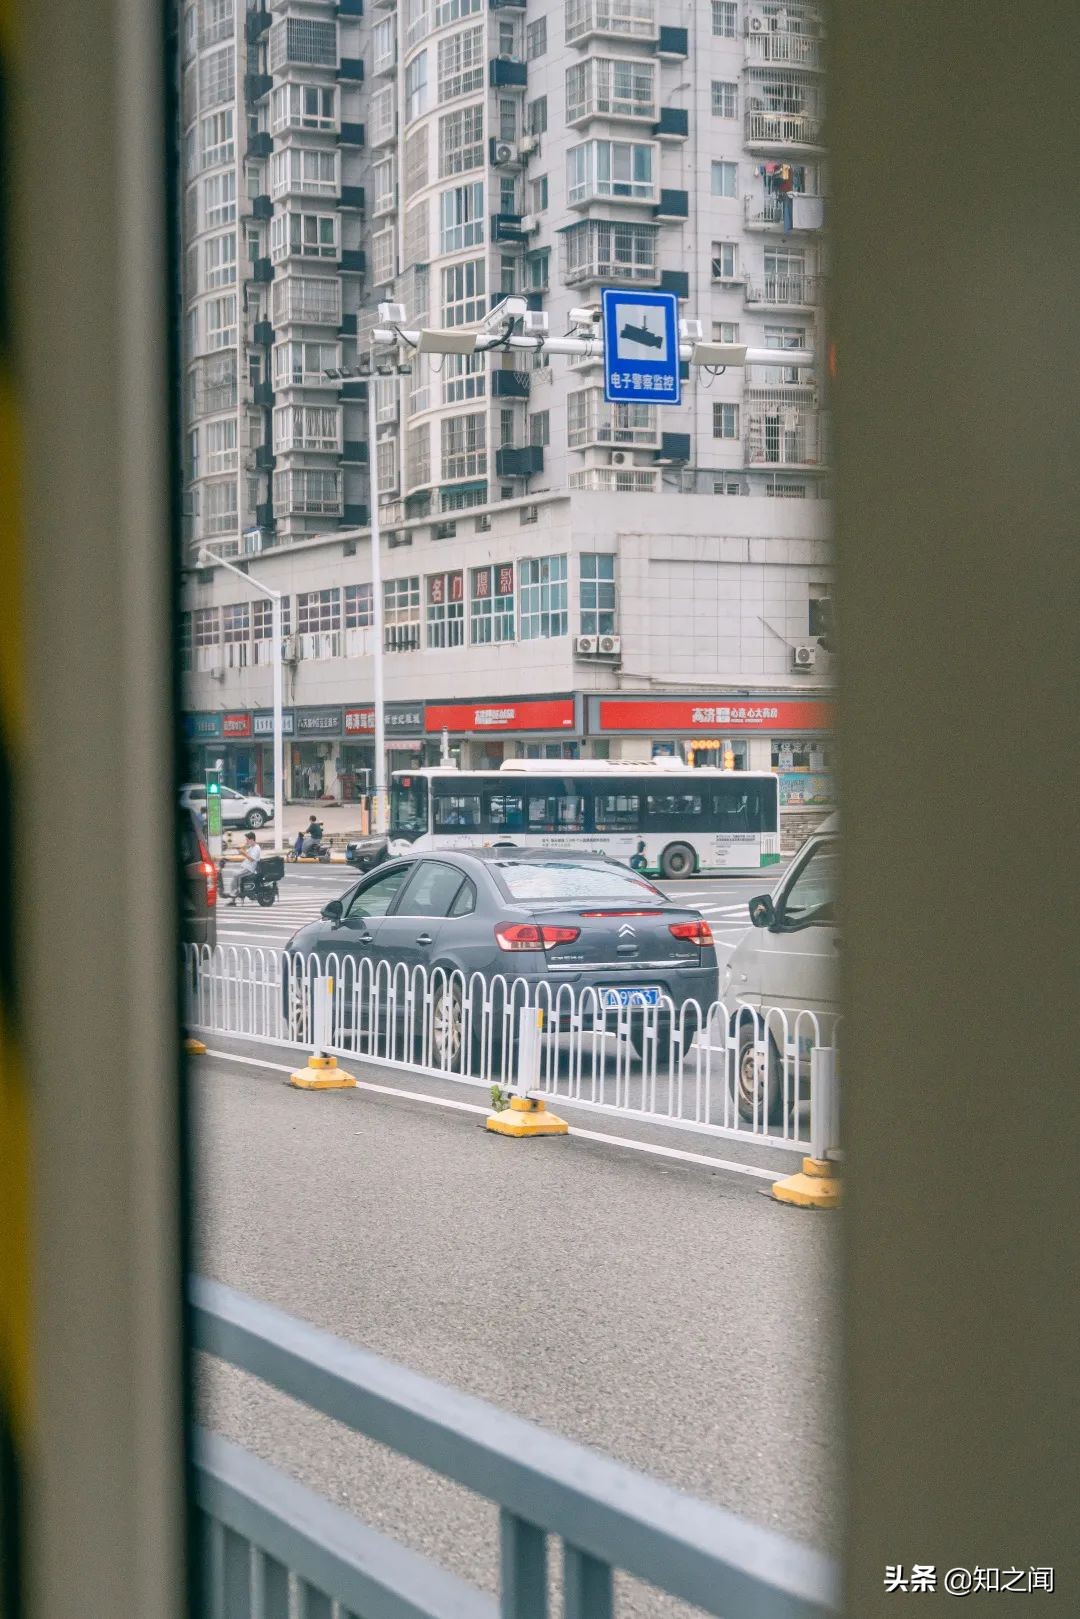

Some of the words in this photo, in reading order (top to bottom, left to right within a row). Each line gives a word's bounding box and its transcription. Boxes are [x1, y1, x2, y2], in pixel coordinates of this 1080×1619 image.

[610, 372, 675, 391] 电子警察监控
